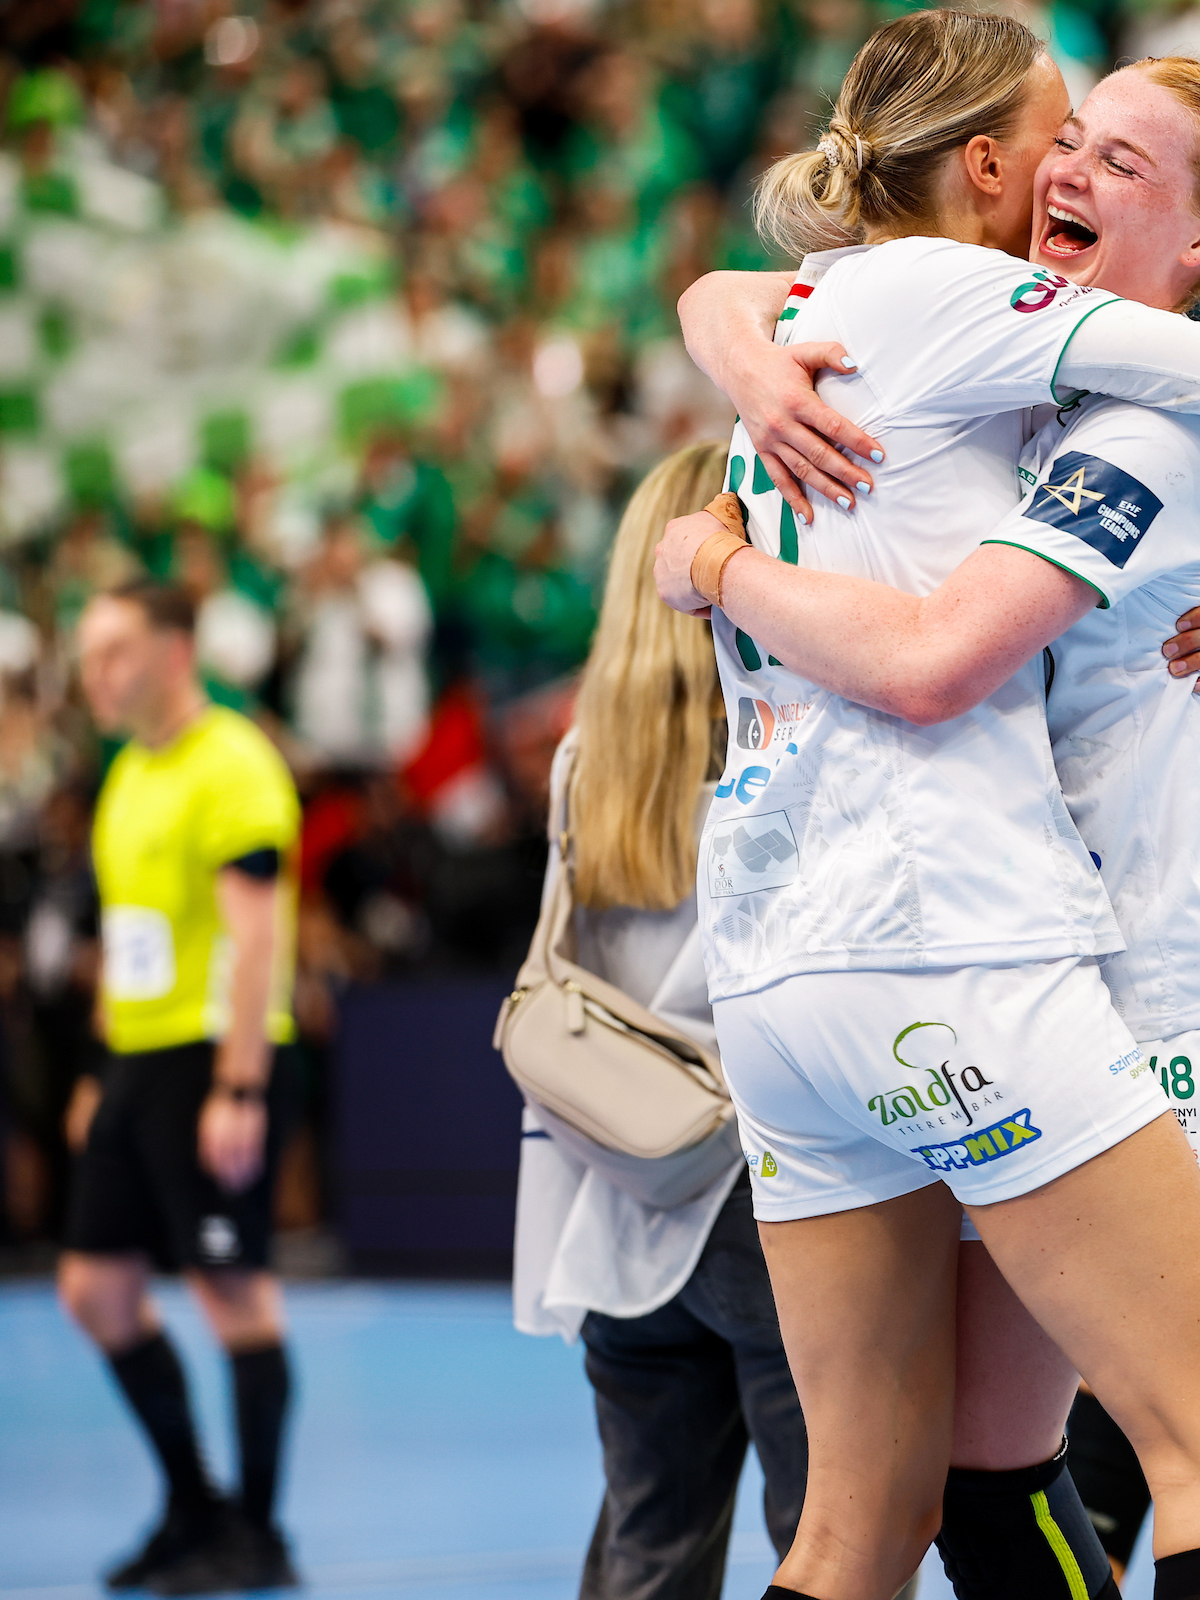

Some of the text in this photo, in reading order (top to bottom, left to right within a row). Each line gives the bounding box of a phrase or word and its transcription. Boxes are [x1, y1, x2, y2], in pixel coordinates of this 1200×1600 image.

[1119, 500, 1142, 514] EHF
[1097, 503, 1140, 540] CHAMPIONS
[1099, 517, 1129, 543] LEAGUE
